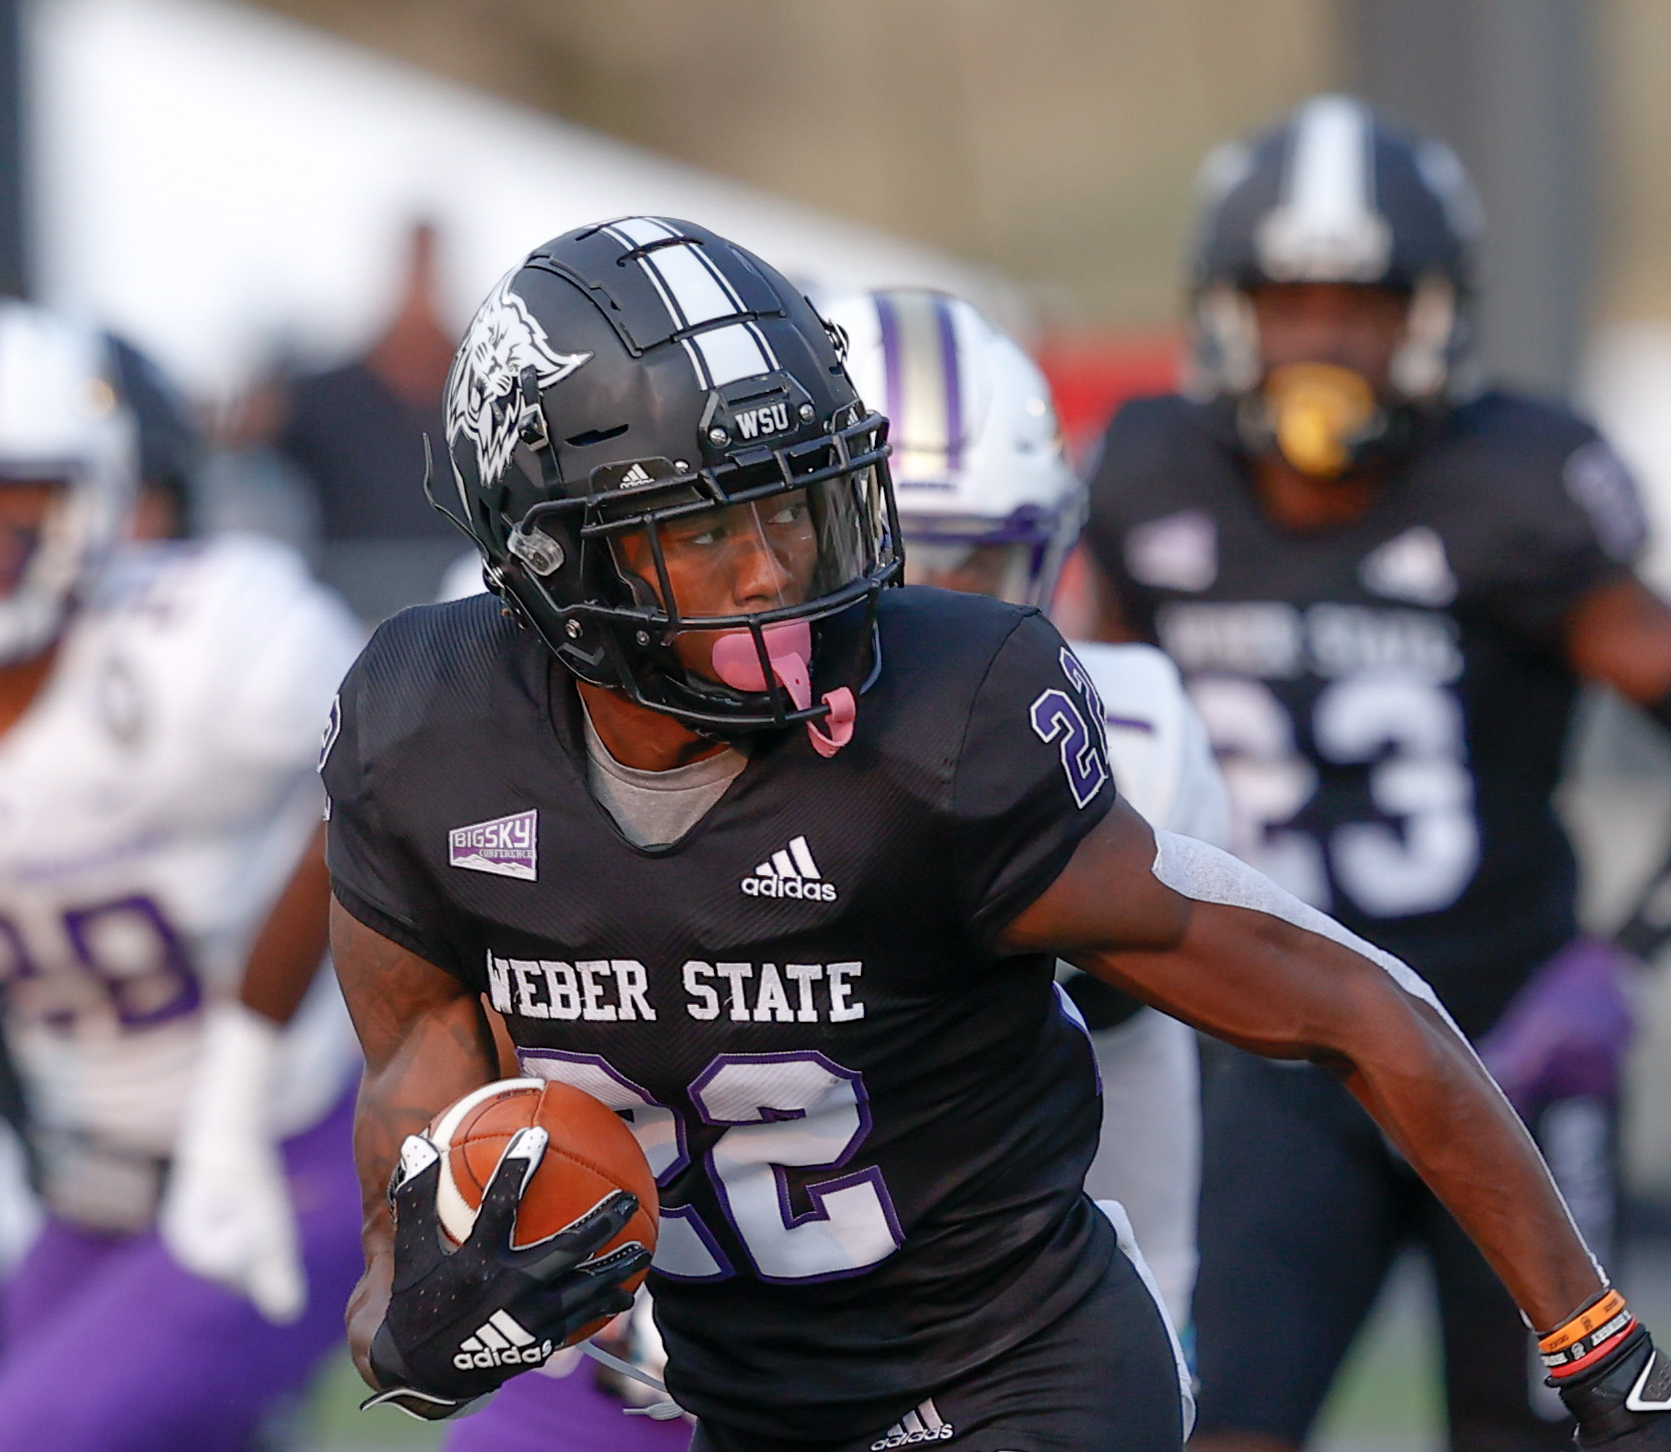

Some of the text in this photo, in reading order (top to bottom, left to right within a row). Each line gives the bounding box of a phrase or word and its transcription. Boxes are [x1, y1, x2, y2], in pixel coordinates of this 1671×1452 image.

[735, 403, 789, 439] WSU
[454, 818, 530, 849] BIG SKY
[479, 848, 533, 859] CONFERENCE
[741, 873, 837, 902] adidas
[487, 949, 865, 1023] WEBER STATE
[453, 1339, 552, 1371] adidas
[870, 1423, 954, 1451] adidas
